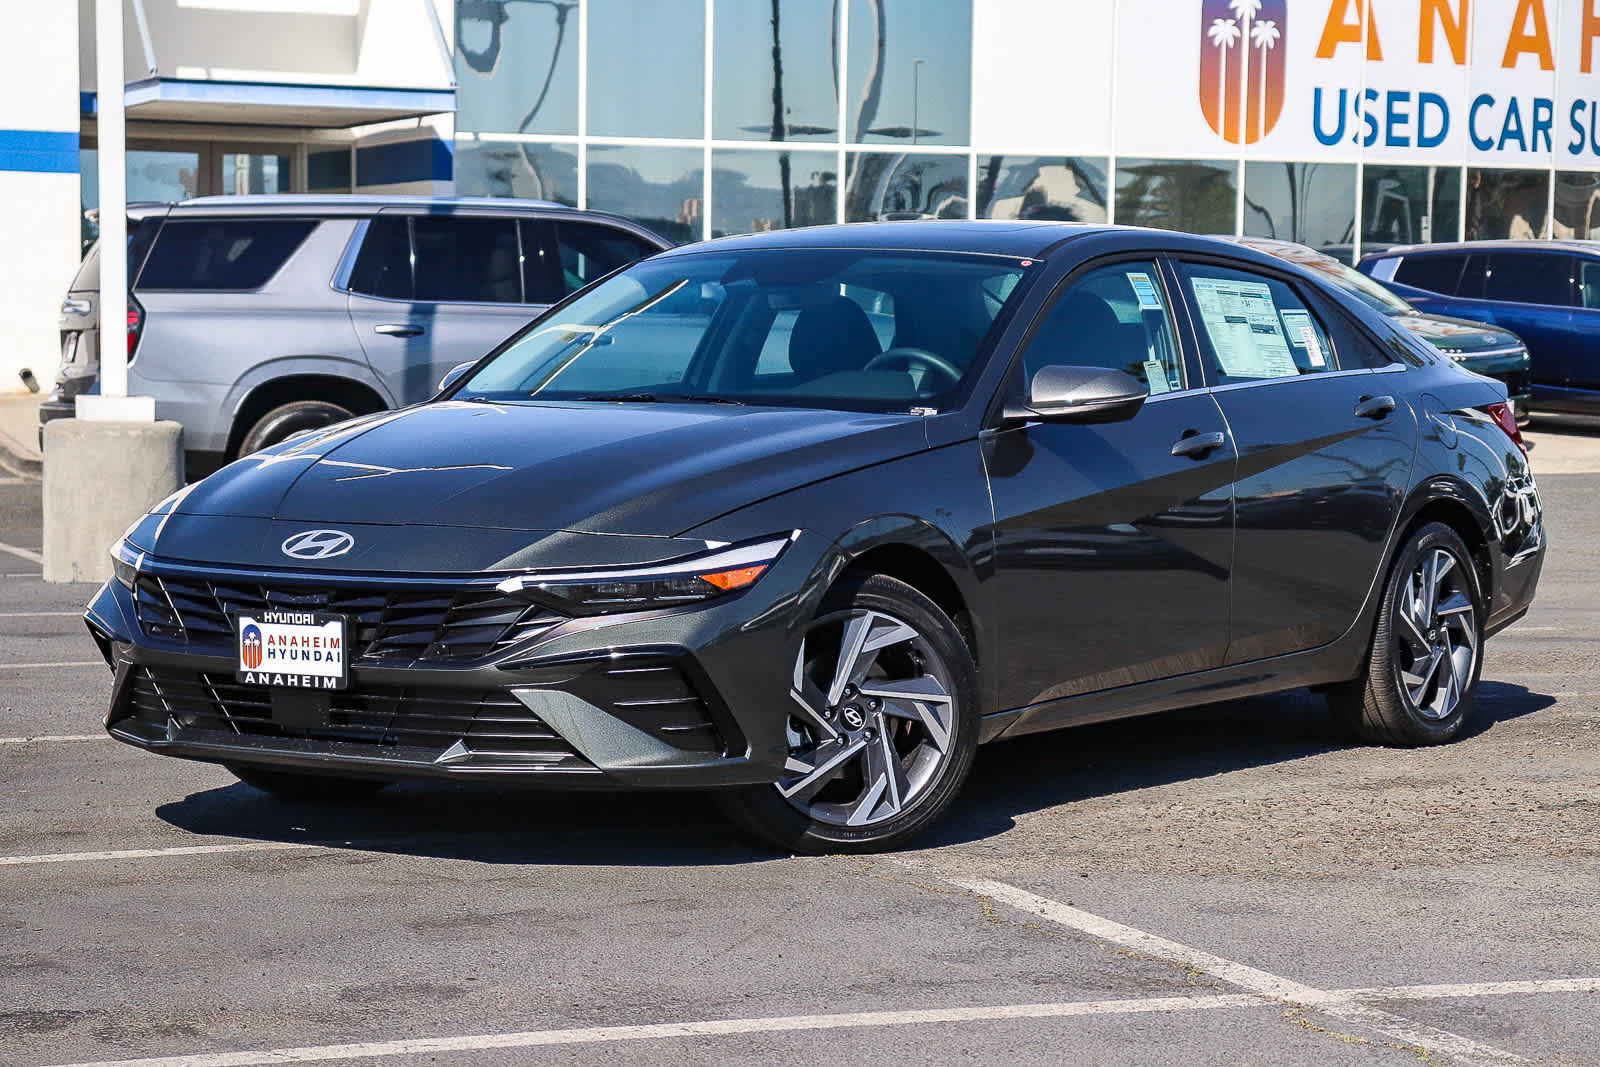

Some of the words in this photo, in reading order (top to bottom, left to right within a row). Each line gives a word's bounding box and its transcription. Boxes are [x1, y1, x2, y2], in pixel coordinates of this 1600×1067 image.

[1313, 88, 1450, 148] USED
[1469, 93, 1553, 153] CAR
[263, 611, 315, 625] HYUNDAI
[267, 634, 341, 649] ANAHEIM
[267, 648, 341, 663] HYUNDAI
[244, 672, 337, 689] ANAHEIM
